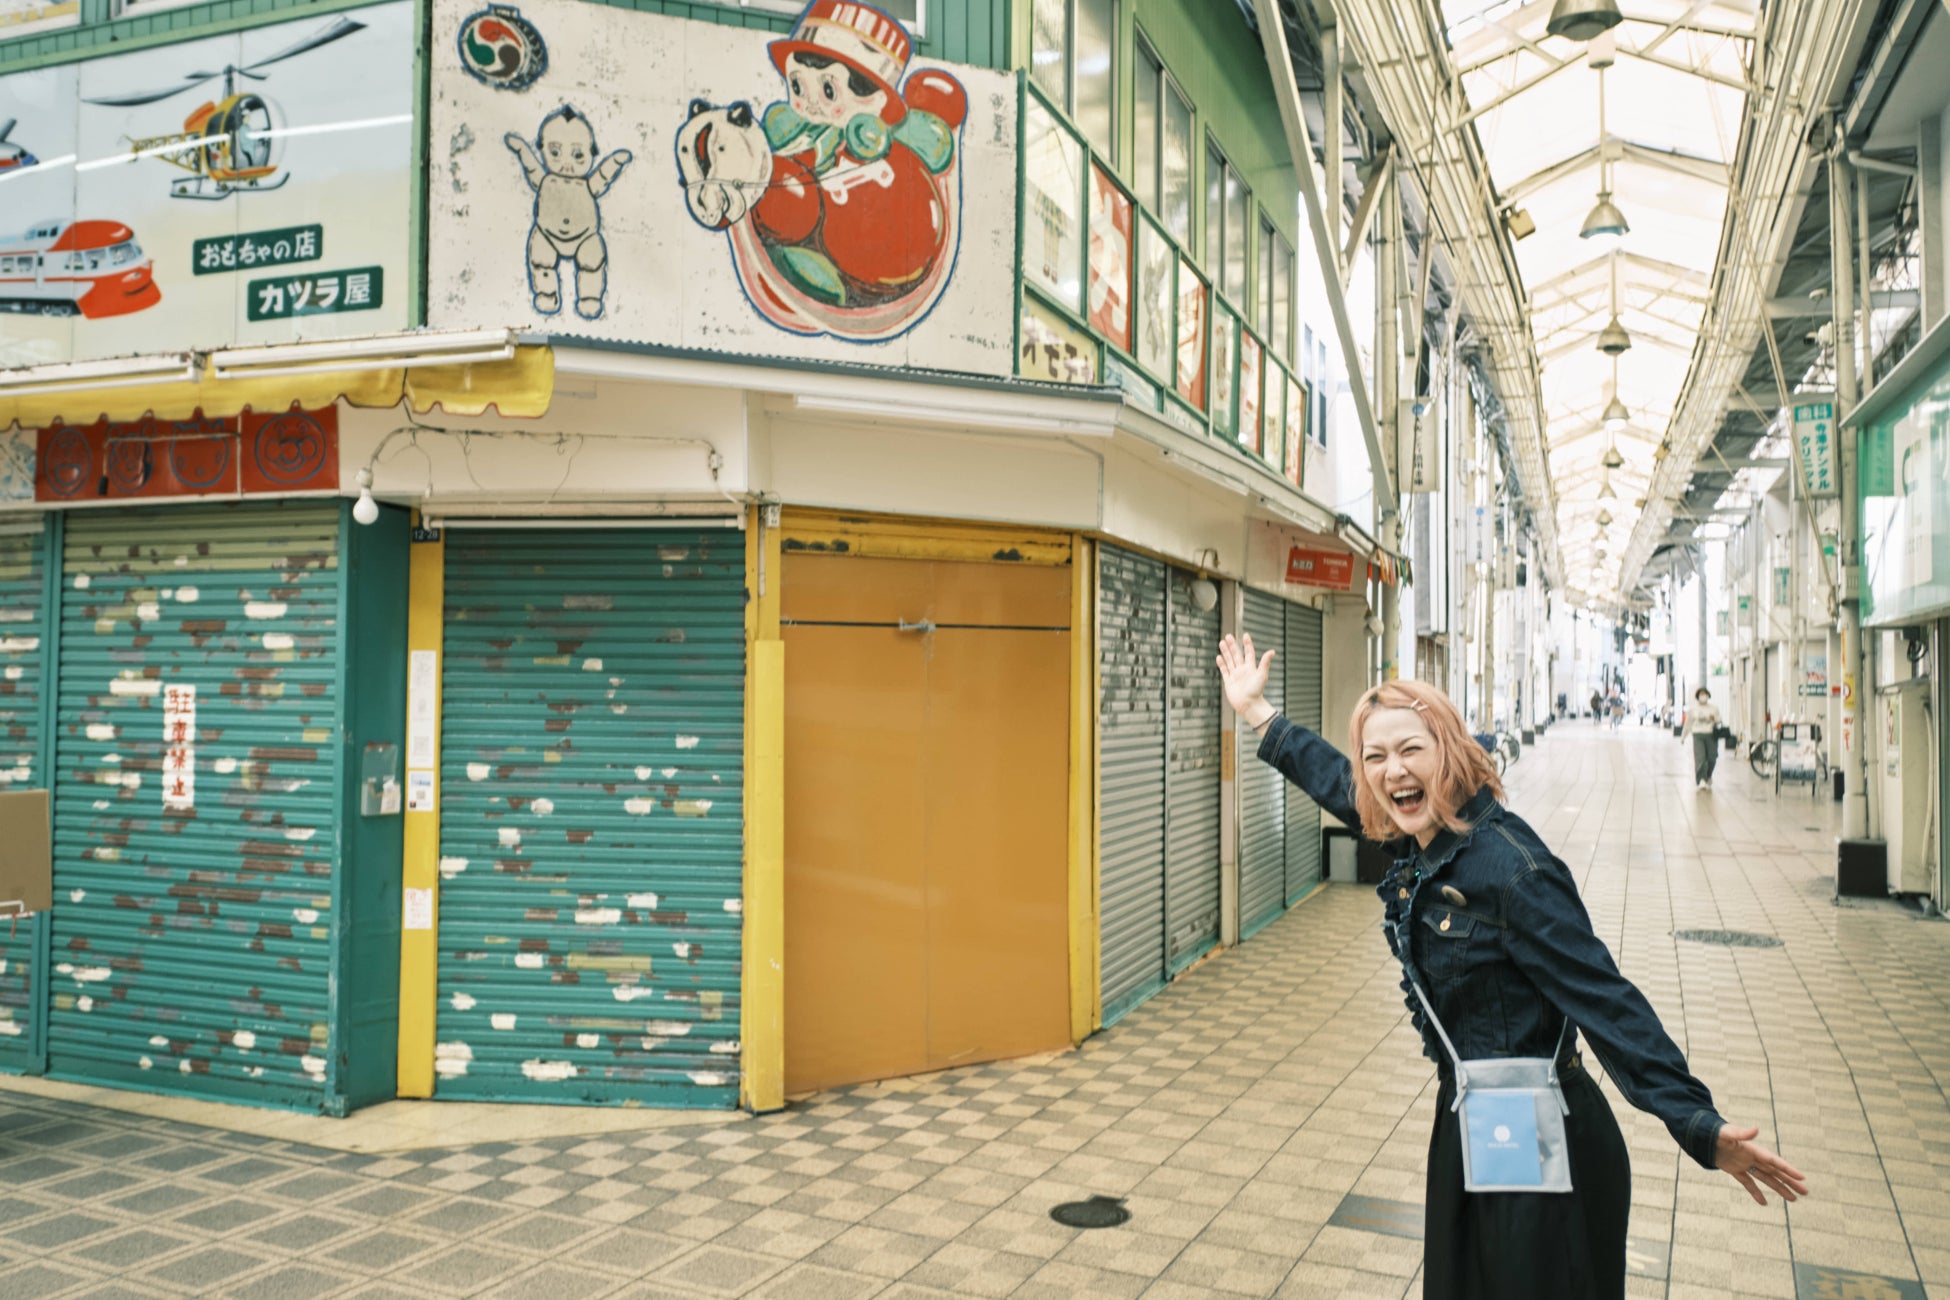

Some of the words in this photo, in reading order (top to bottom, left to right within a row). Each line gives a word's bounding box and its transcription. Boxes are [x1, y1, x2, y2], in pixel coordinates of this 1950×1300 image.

[201, 230, 316, 268] おもちゃの店
[258, 273, 371, 314] カツラ屋
[166, 688, 192, 797] 駐車禁止
